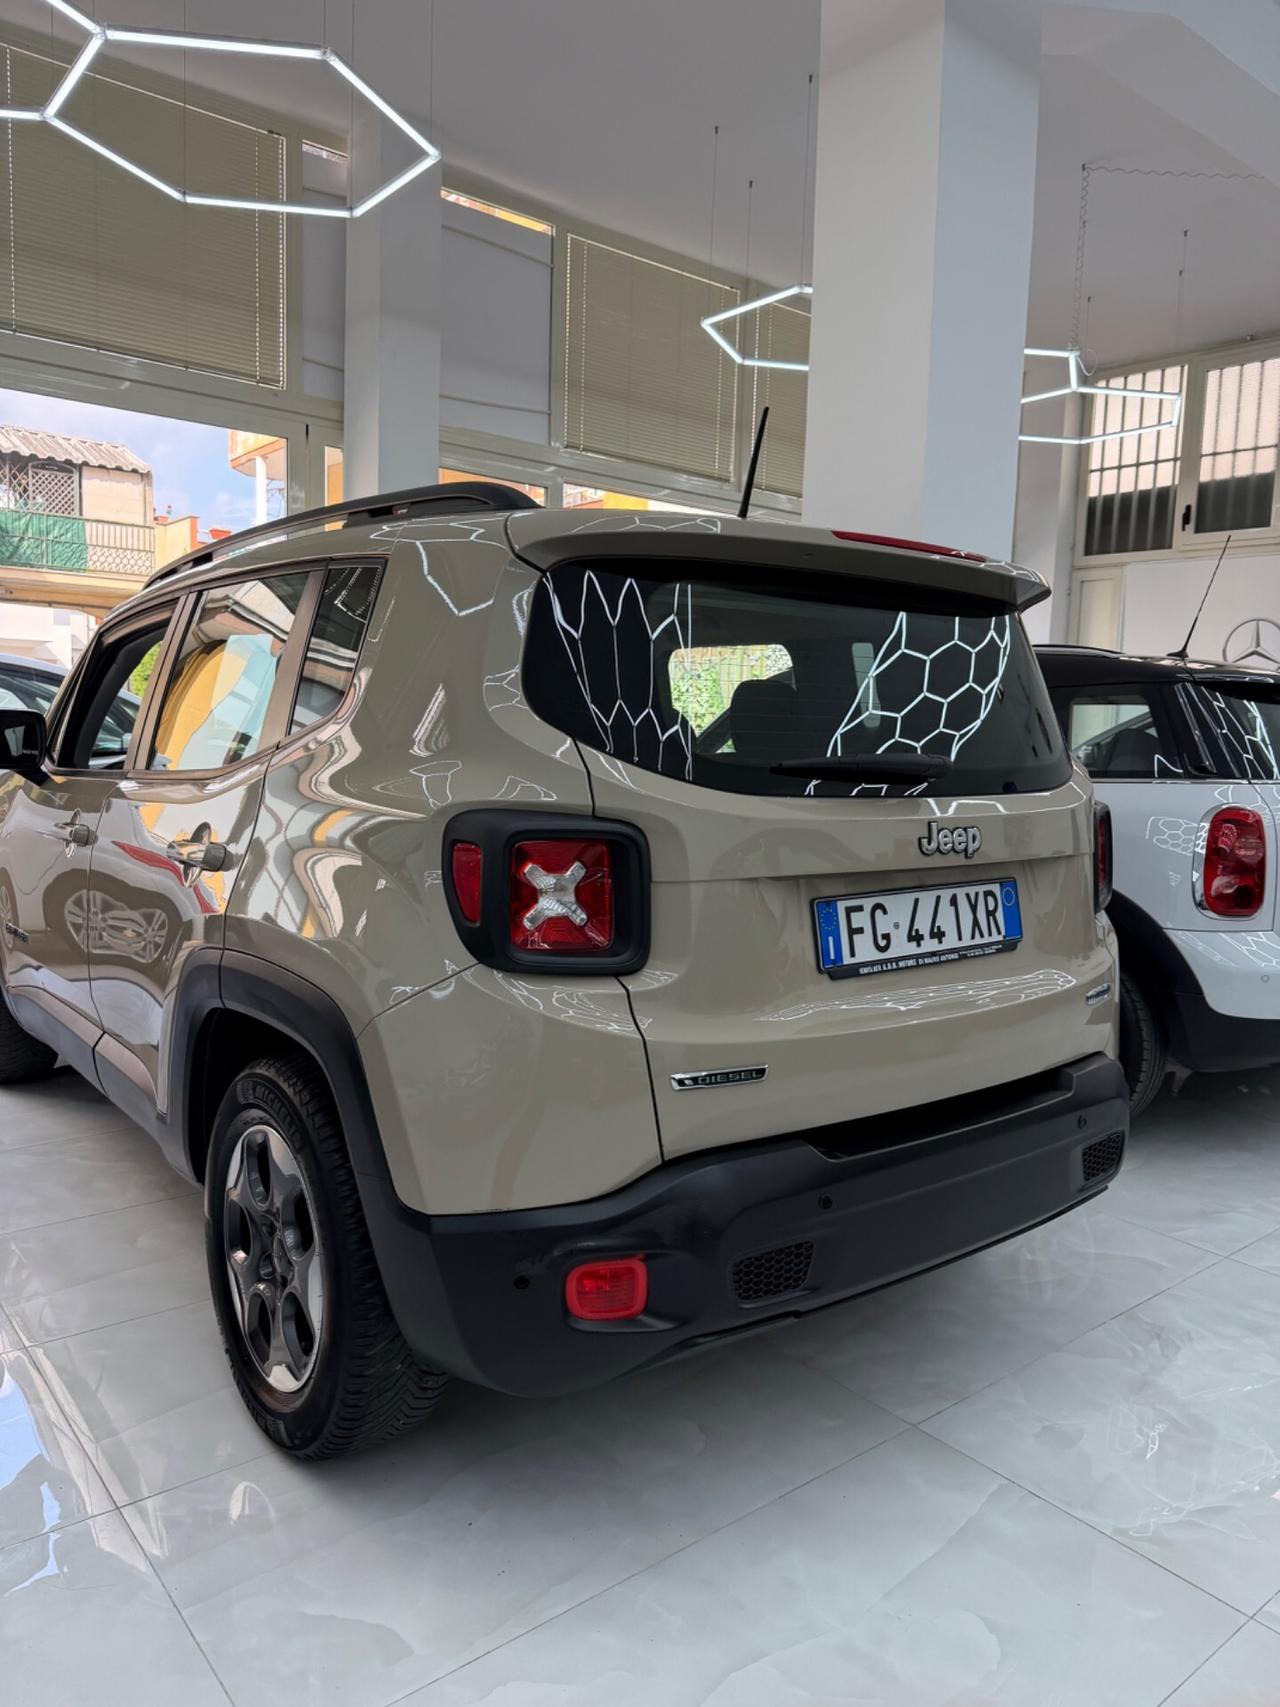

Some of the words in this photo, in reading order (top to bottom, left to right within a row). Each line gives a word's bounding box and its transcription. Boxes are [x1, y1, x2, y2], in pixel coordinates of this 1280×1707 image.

[919, 821, 982, 859] Jeep
[844, 902, 892, 958] FG
[907, 889, 1003, 948] 441XR
[697, 1070, 763, 1084] DIESEL
